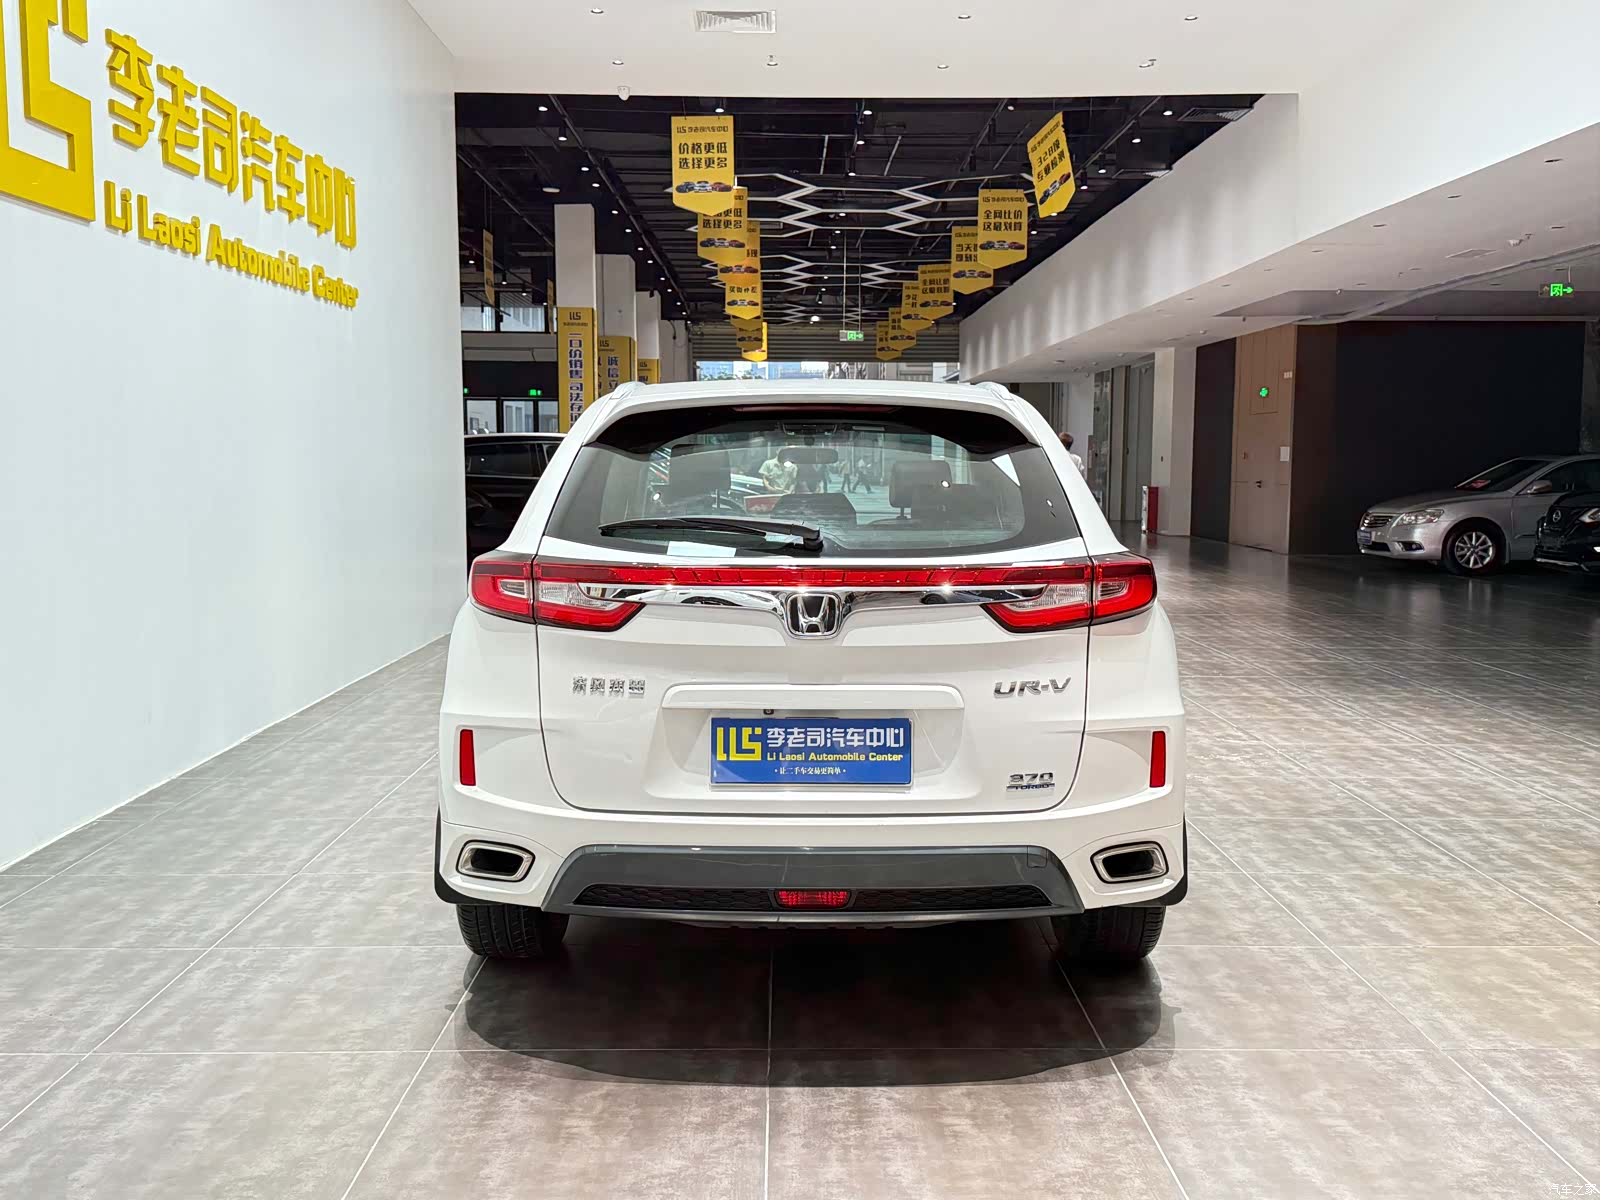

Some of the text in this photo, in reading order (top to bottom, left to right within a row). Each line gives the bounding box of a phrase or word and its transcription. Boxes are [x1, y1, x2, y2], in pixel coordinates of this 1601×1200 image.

[105, 28, 357, 250] 李老司汽车中心
[678, 142, 728, 155] 价格更低
[678, 157, 728, 170] 选择更多
[983, 209, 1023, 220] 全网比价
[703, 218, 742, 230] 选择更多
[983, 221, 1023, 232] 这最划算
[104, 180, 359, 310] Li Laosi Automobile Center
[568, 332, 583, 379] 一口价销售
[994, 677, 1072, 699] UR-V
[766, 727, 904, 748] 李老司汽车中心
[767, 752, 904, 761] Li Laosi Automobile Center
[1009, 772, 1054, 783] 370
